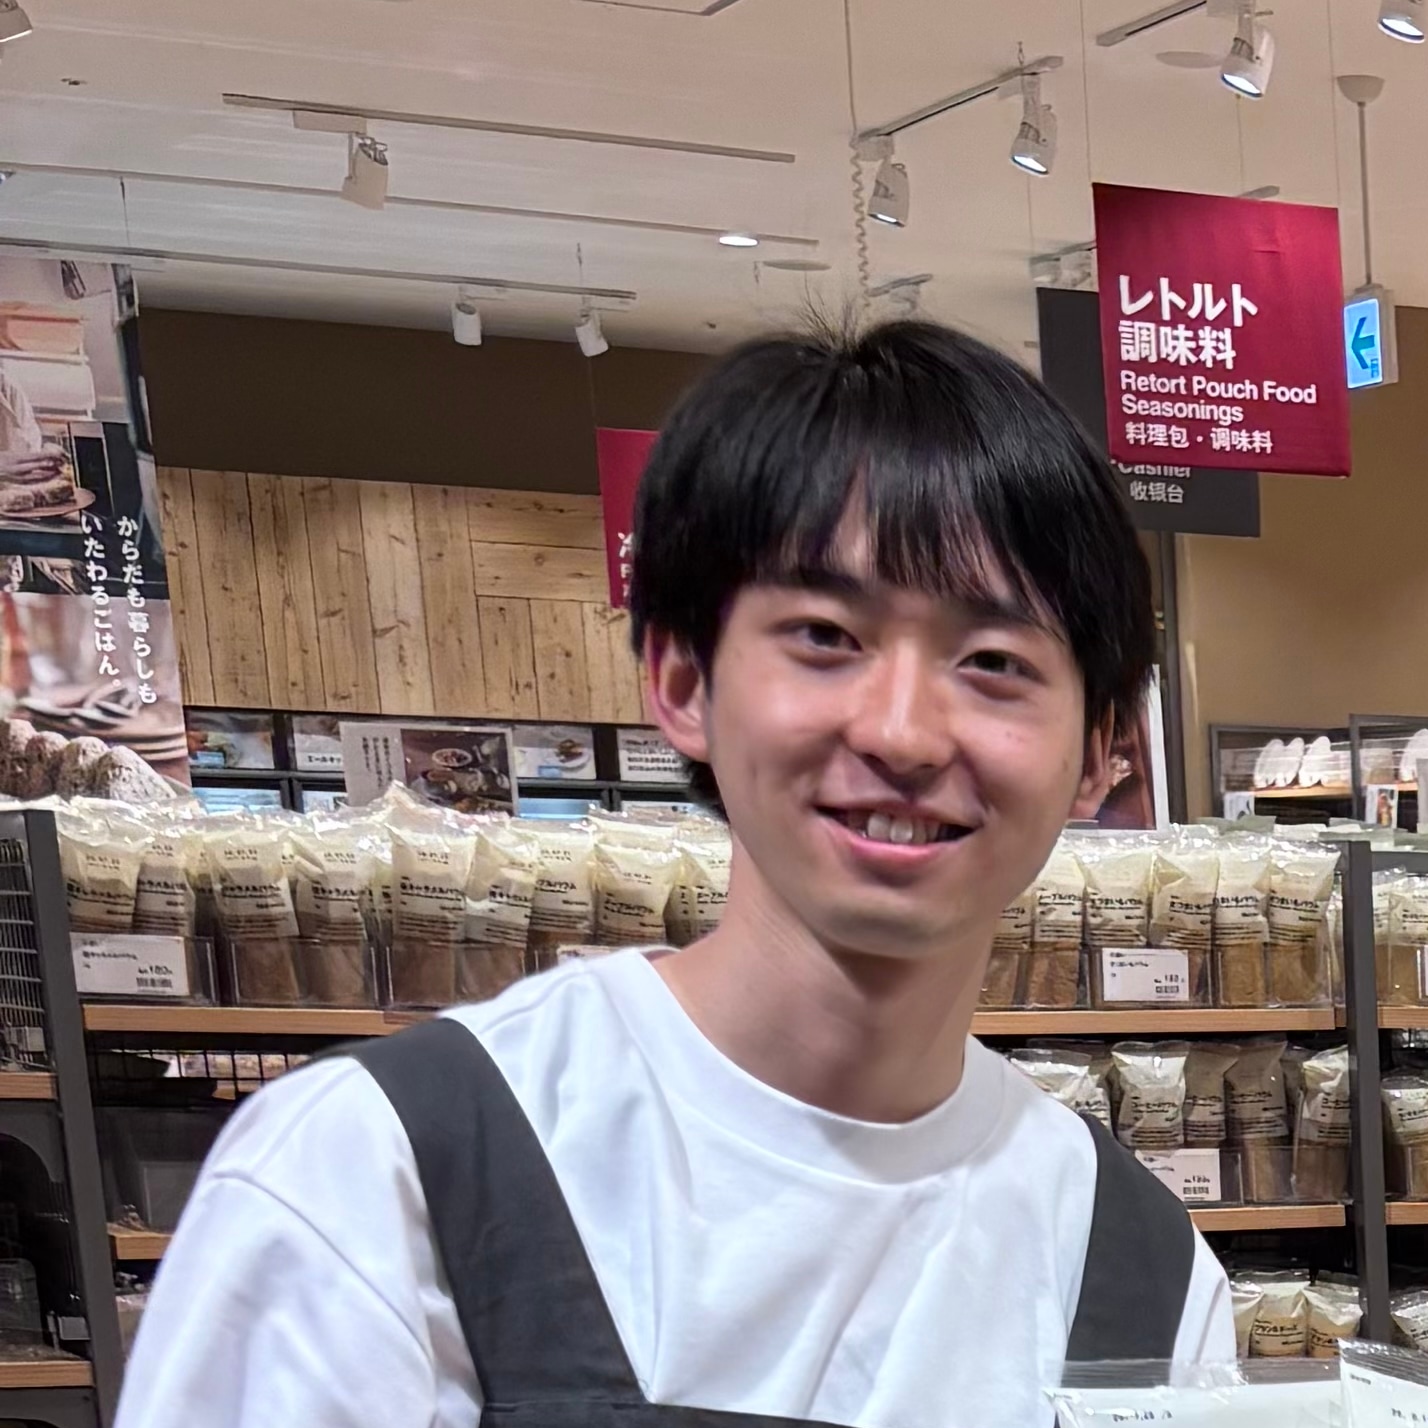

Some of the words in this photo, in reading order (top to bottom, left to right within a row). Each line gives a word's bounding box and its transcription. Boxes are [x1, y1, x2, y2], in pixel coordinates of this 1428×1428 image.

[1118, 274, 1258, 327] レトルト
[1118, 320, 1236, 369] 調味料
[1121, 370, 1186, 394] Retort
[1192, 376, 1258, 401] Pouch
[1262, 381, 1317, 404] Food
[1121, 394, 1244, 426] Seasonings
[80, 514, 124, 691] いたわるごはん。
[116, 515, 157, 706] からだも暮らしも
